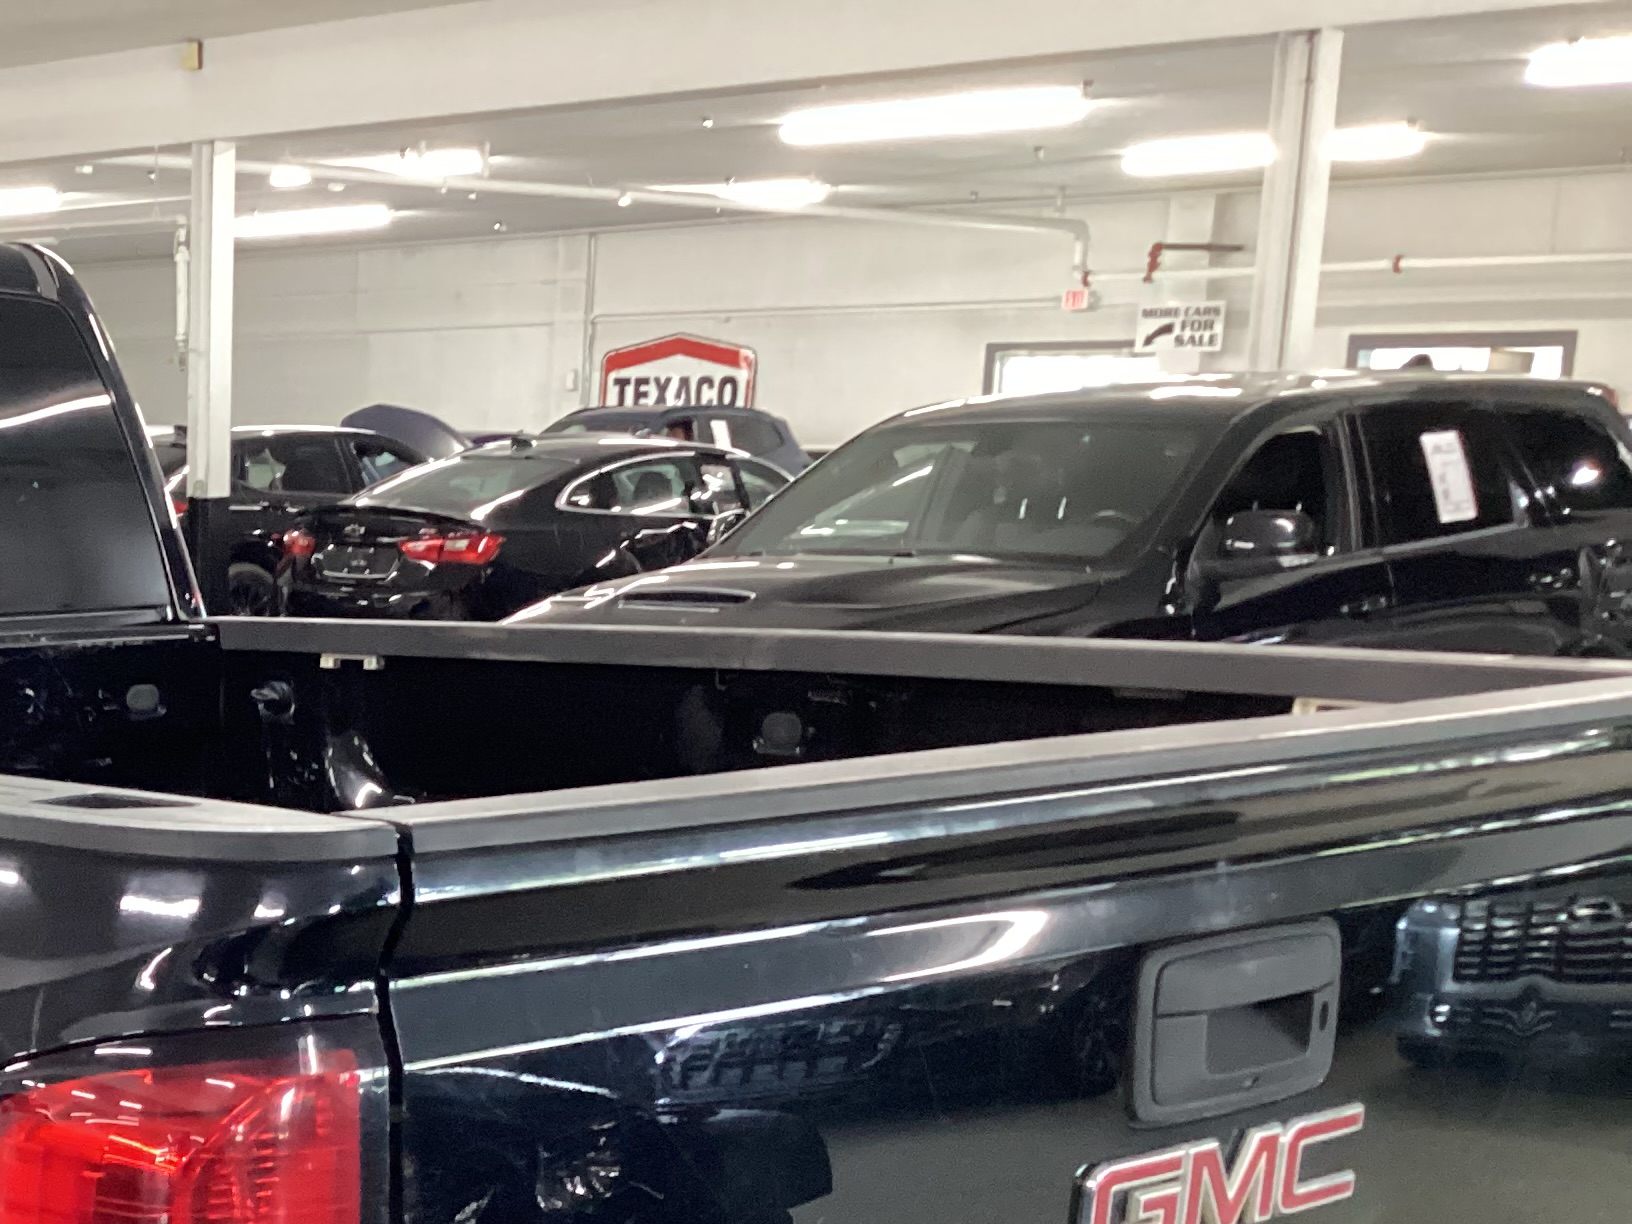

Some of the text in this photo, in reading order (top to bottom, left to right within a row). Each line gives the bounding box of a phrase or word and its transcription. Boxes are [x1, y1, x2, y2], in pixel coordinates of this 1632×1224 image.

[1183, 305, 1221, 317] CARS
[1180, 319, 1215, 332] FOR
[1174, 333, 1219, 348] SALE
[613, 375, 739, 408] TEXACO
